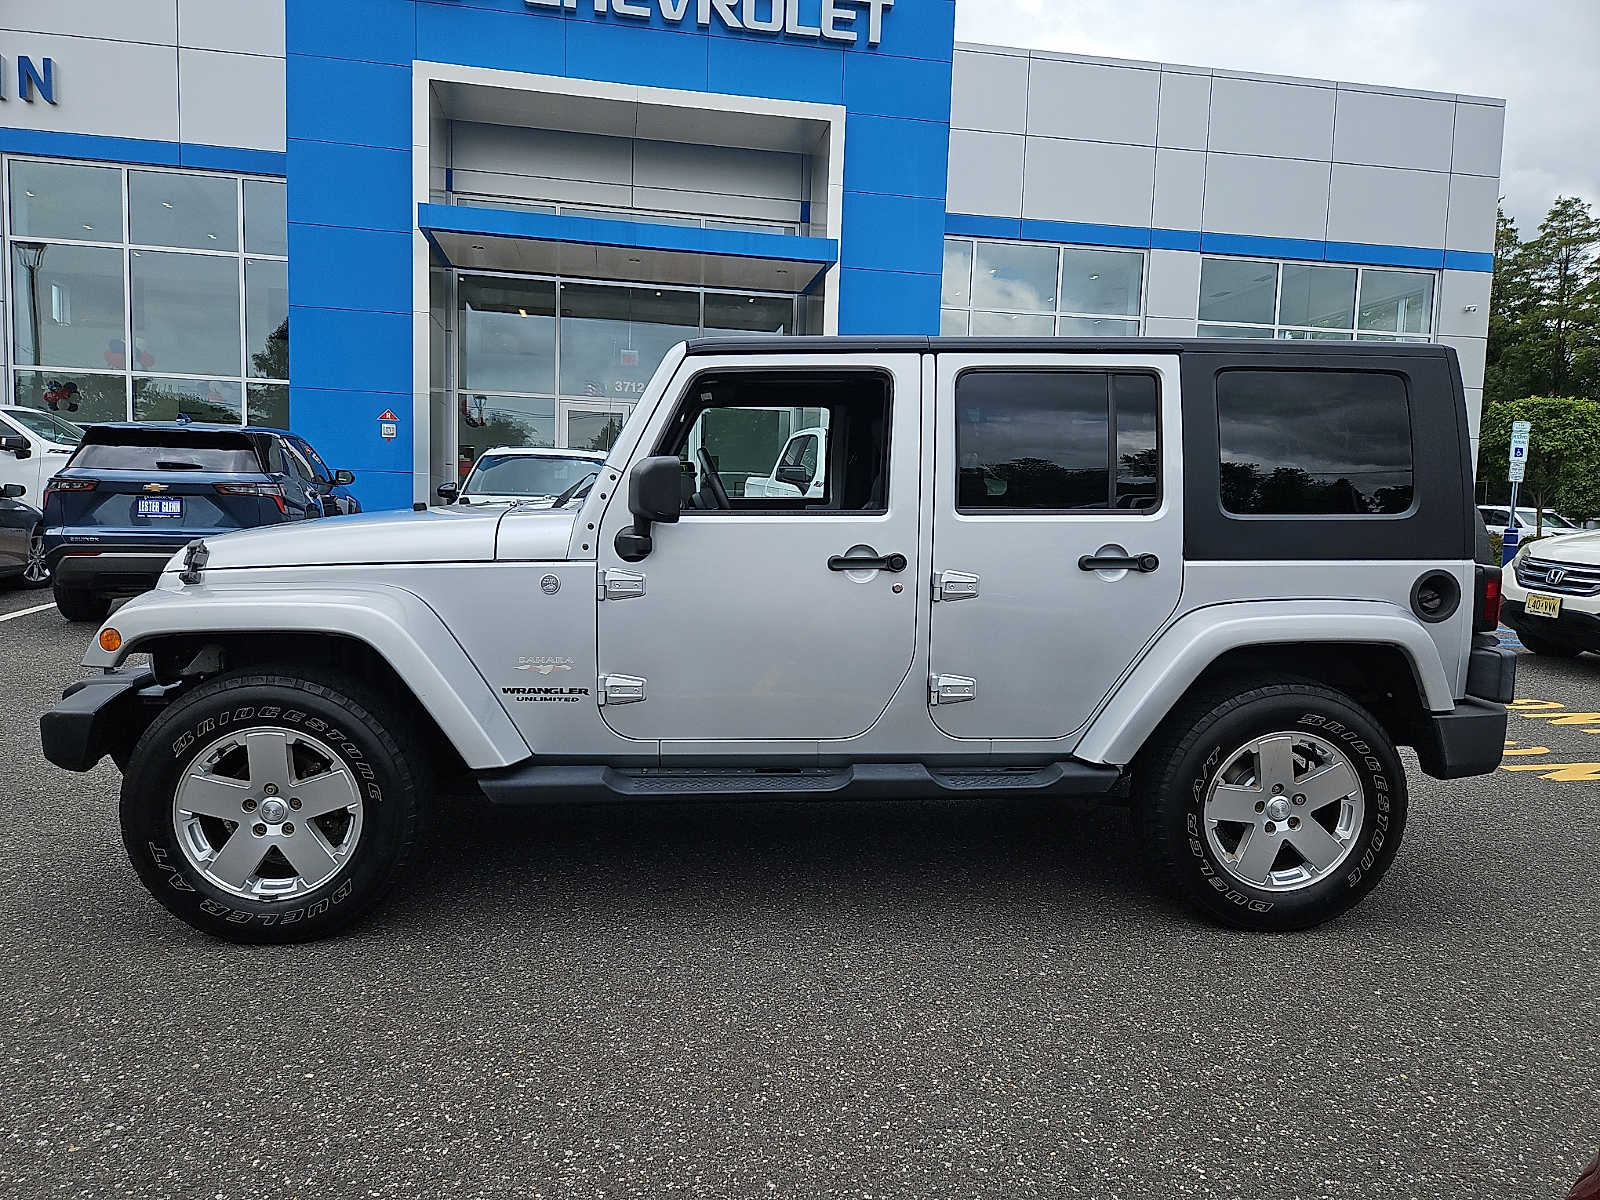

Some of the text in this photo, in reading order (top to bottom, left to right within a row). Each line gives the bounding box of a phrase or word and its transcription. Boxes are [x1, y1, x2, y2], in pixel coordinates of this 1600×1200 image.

[523, 0, 895, 45] ROLET
[0, 54, 57, 104] N
[615, 380, 645, 393] 3712
[138, 499, 181, 513] LESTER GLENN
[518, 656, 576, 664] SAHARA
[501, 687, 590, 696] WRANGLER
[172, 706, 382, 801] BRIDGESTONE
[1297, 713, 1390, 887] BRIDGESTONE
[1187, 746, 1274, 912] DUELER A/T
[148, 841, 353, 926] DUELER A/T
